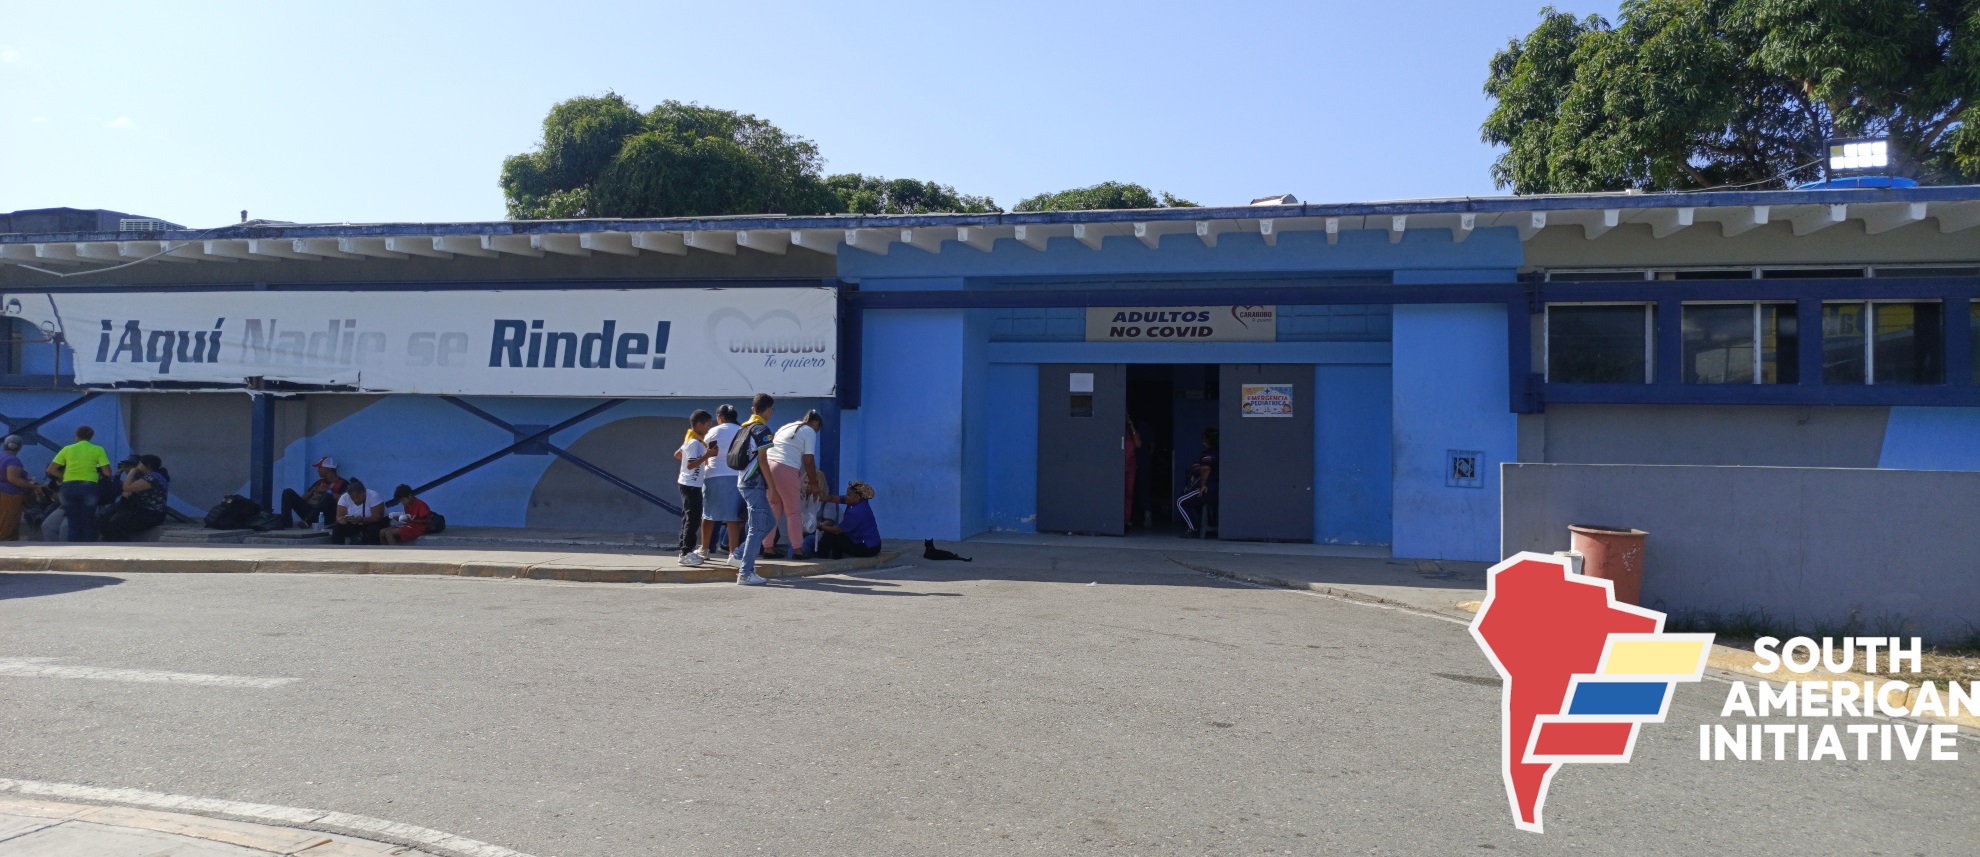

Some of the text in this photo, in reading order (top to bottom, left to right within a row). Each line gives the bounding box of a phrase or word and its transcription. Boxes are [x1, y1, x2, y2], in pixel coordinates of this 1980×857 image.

[1112, 311, 1210, 323] ADULTOS
[1109, 326, 1213, 338] NO COVID
[95, 317, 671, 374] ¡Aquí Nadie se Rinde!
[729, 335, 826, 354] CARABOBO
[763, 354, 826, 373] Te quiero
